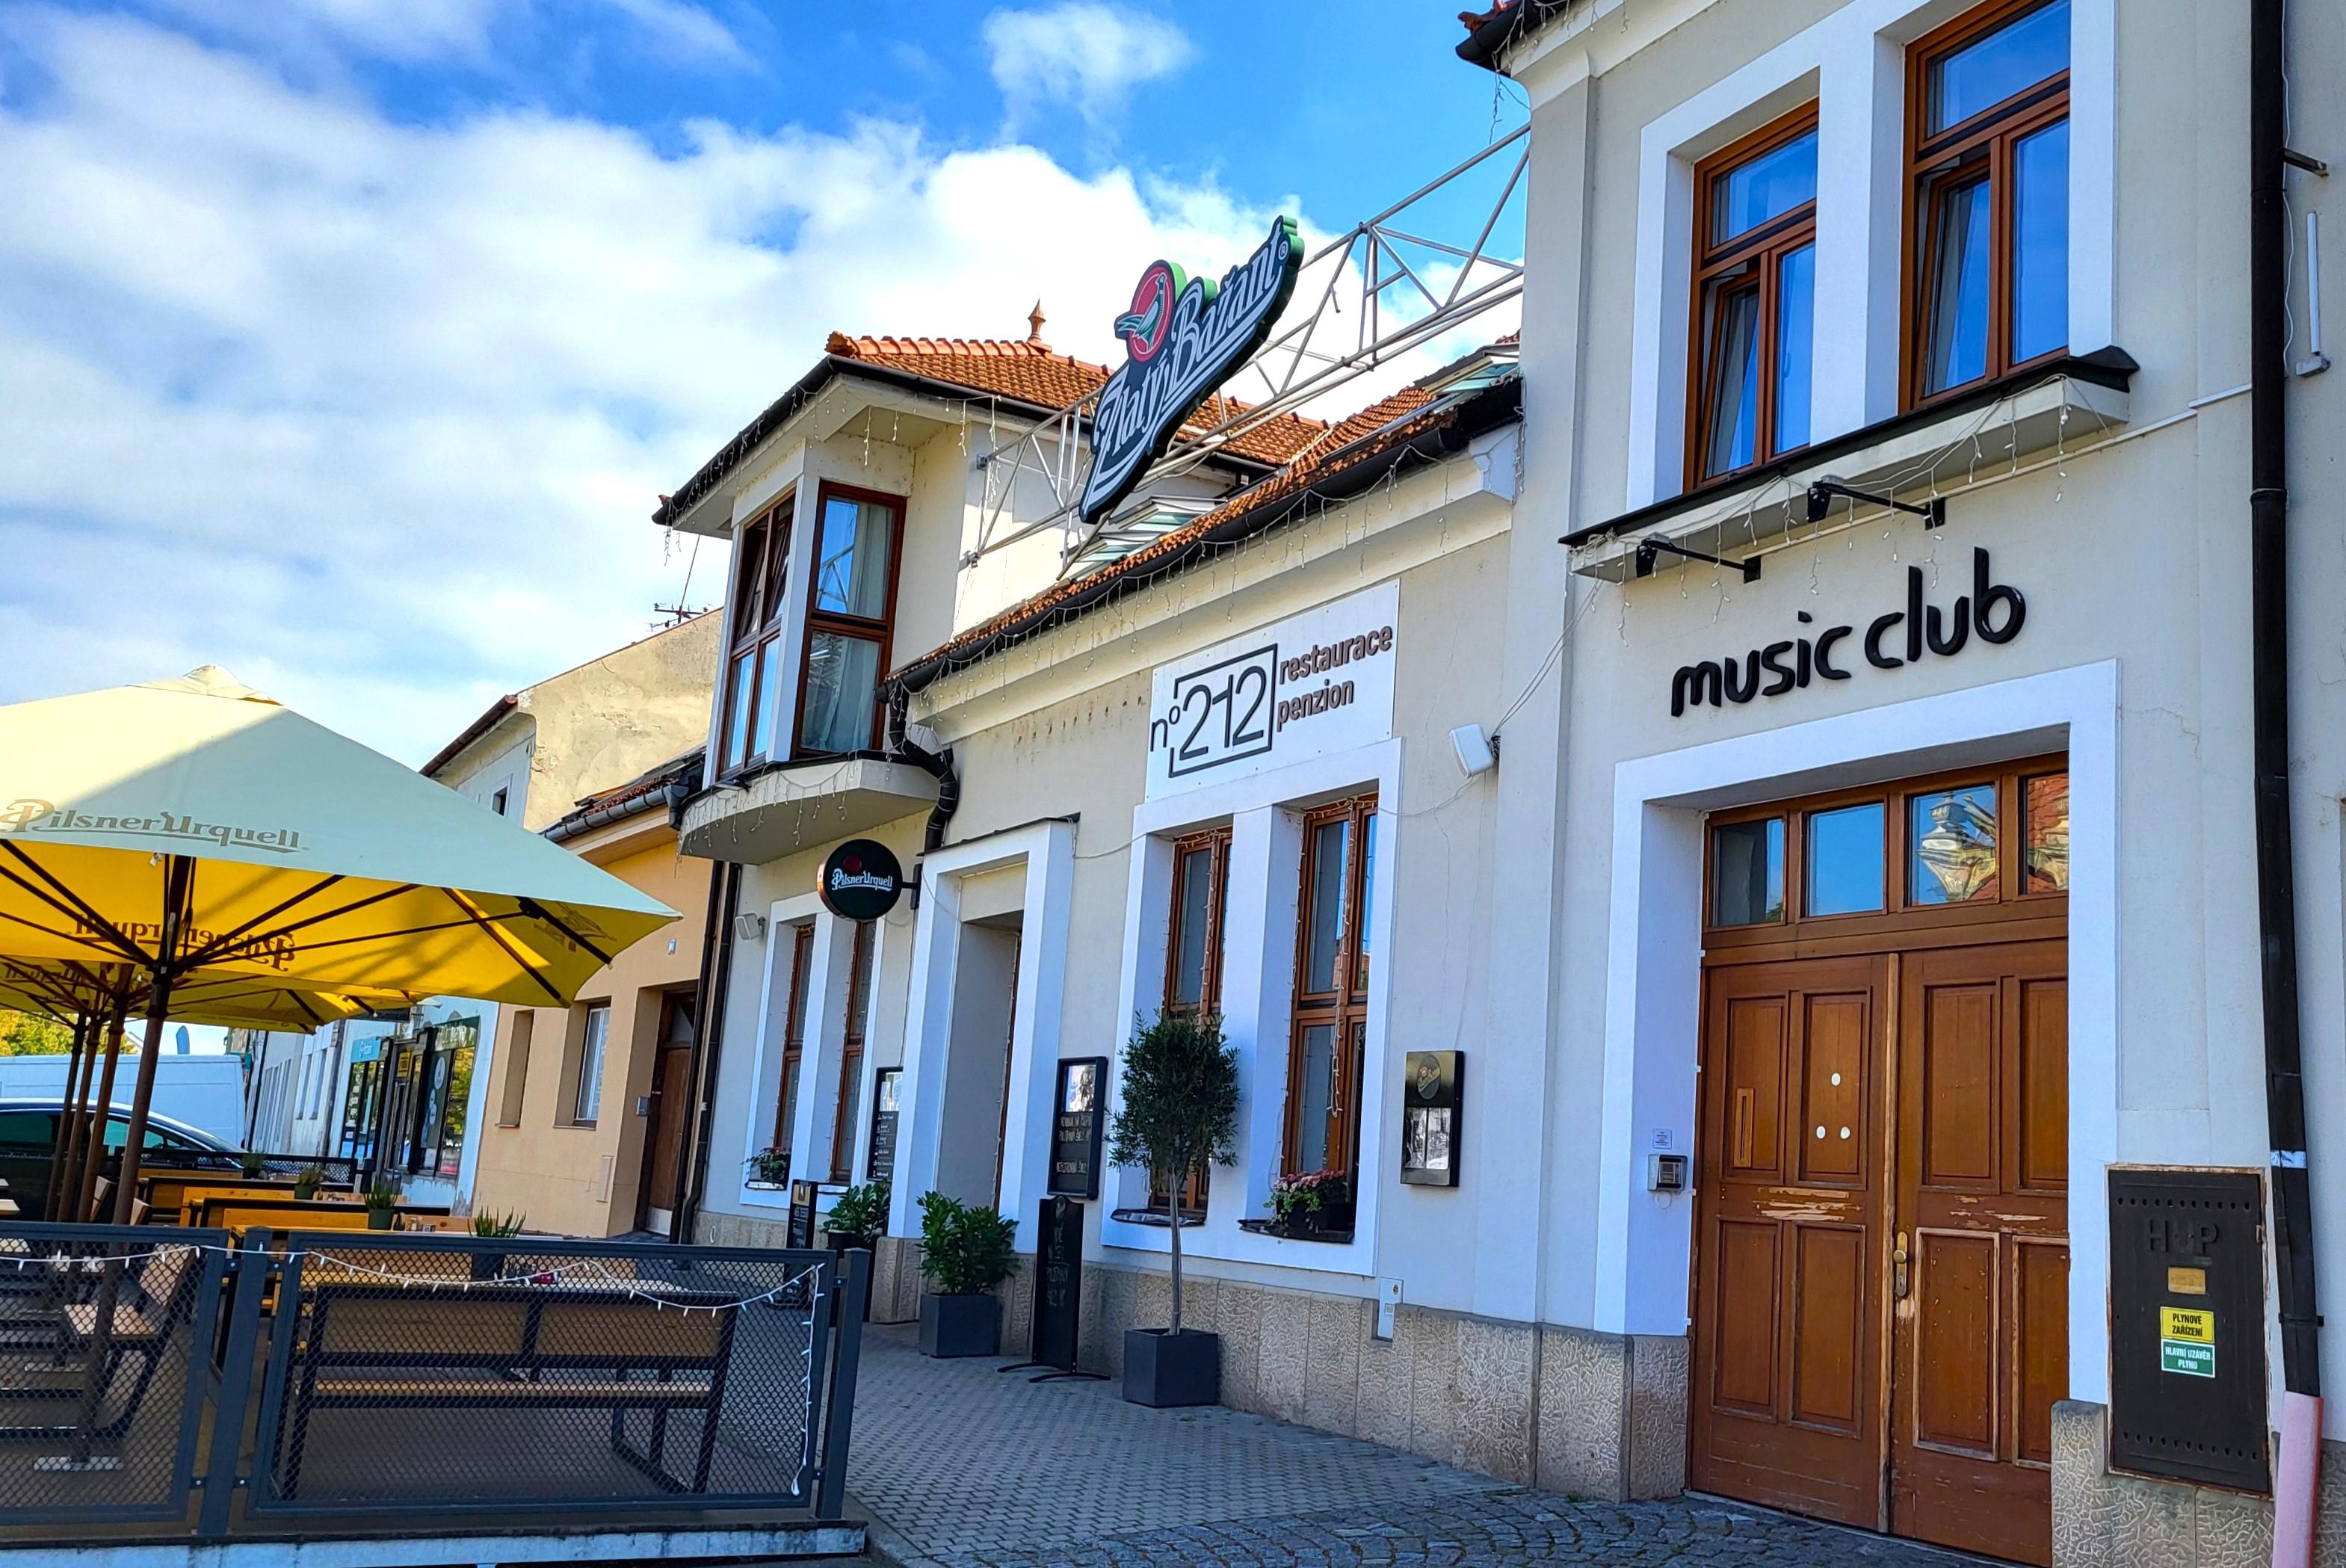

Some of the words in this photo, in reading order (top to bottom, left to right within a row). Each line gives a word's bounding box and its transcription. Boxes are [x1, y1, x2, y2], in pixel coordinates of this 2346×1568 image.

[1279, 625, 1393, 685] restaurace
[1670, 610, 1853, 717] music
[1864, 546, 2027, 669] club
[1179, 665, 1268, 761] 212
[1277, 679, 1355, 732] penzion
[0, 798, 161, 833] Pilsner
[160, 811, 300, 849] Urquell
[2172, 1313, 2203, 1325] PLYNOVÉ
[2172, 1325, 2203, 1337] ZAŘÍZENÍ
